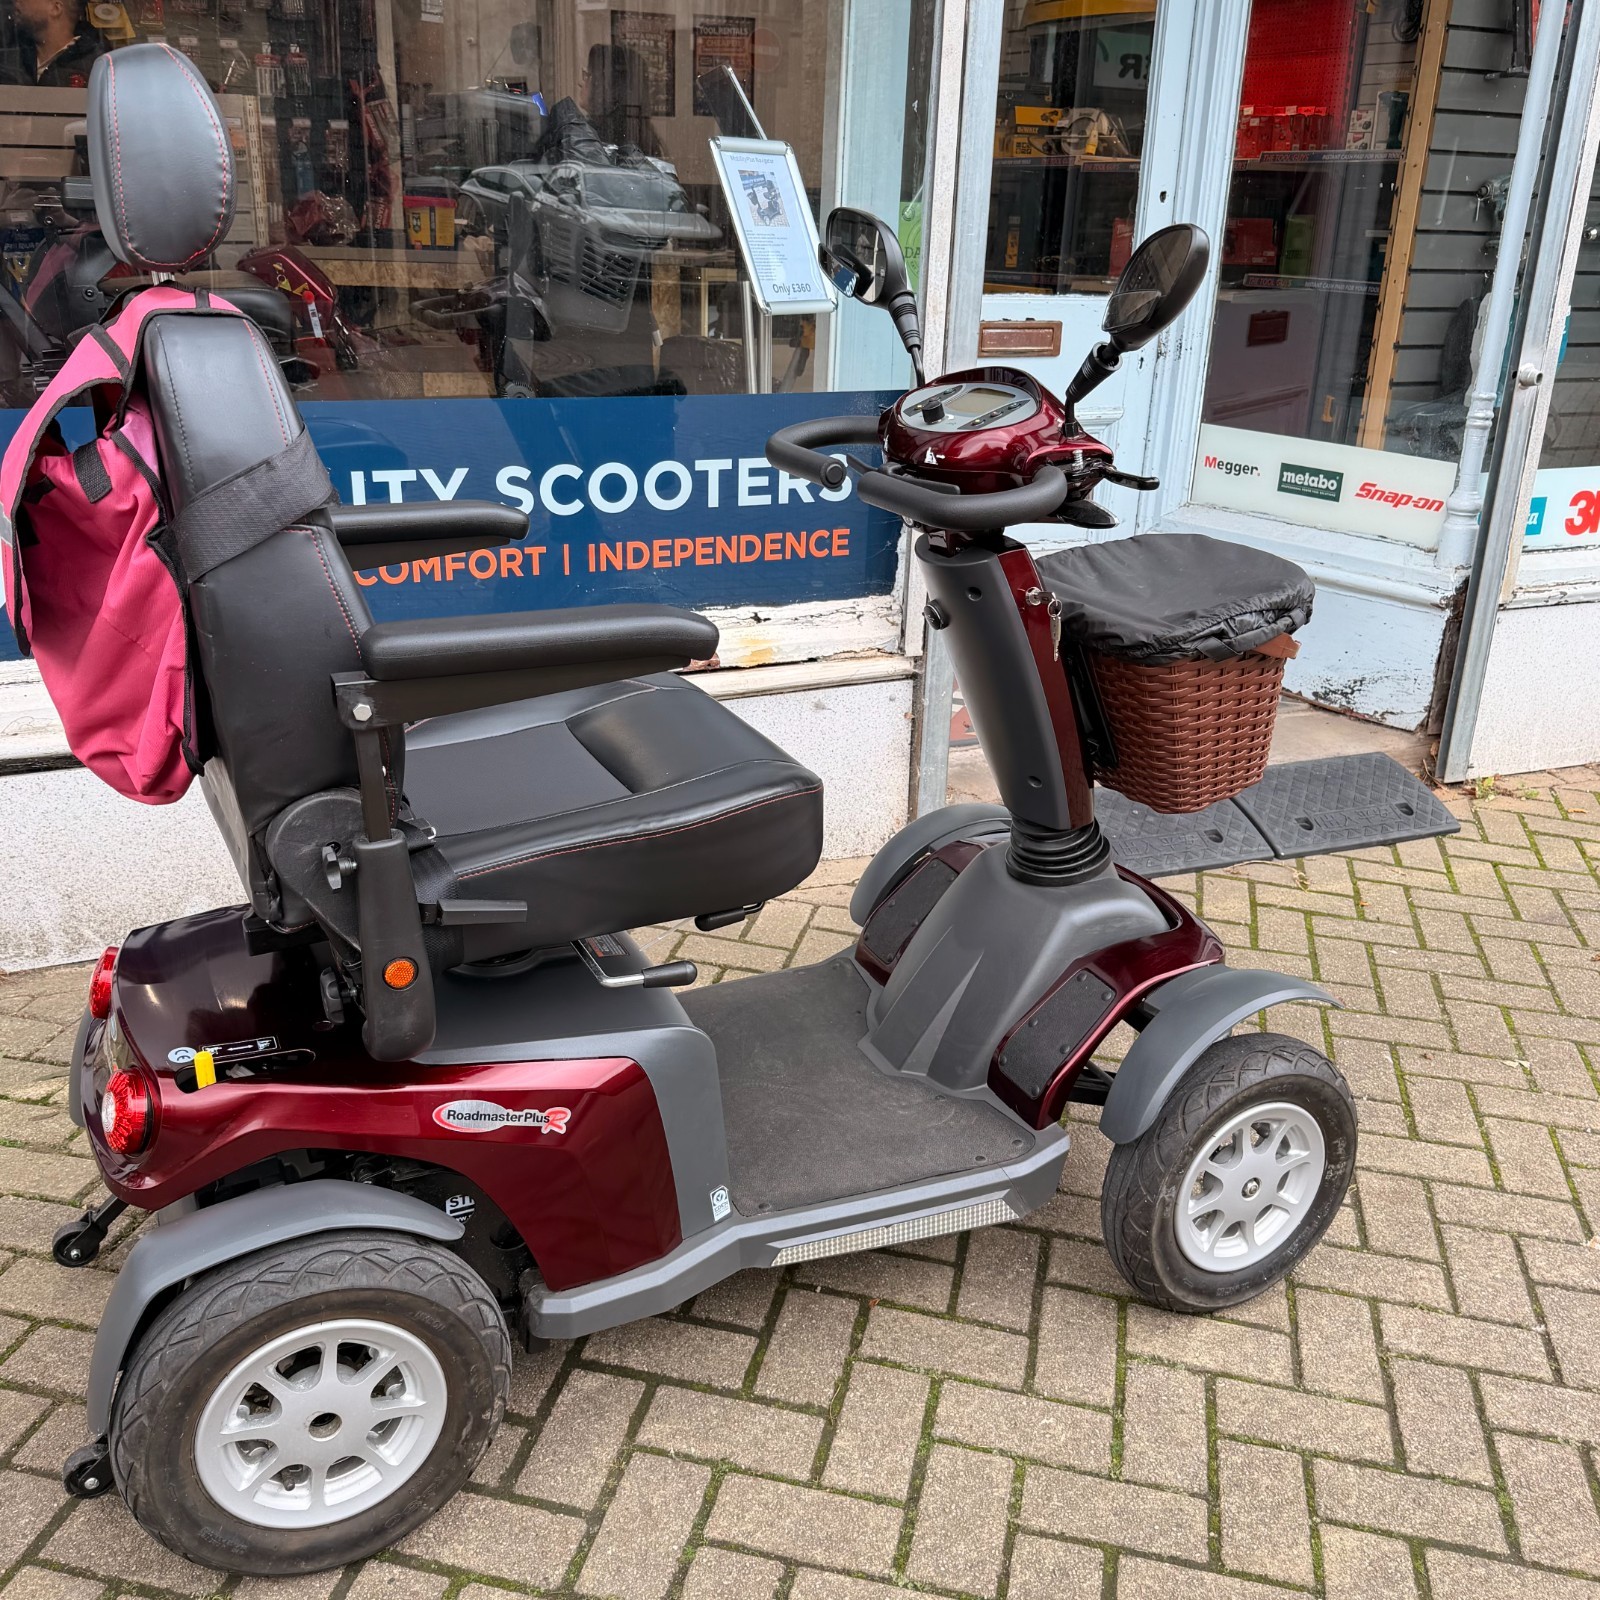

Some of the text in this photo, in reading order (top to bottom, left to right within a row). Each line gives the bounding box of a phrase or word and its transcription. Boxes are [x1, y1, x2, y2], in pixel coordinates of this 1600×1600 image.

[772, 283, 811, 295] Only £360
[1282, 471, 1337, 490] metabo
[1354, 481, 1445, 513] Snap-on
[588, 528, 851, 573] INDEPENDENCE
